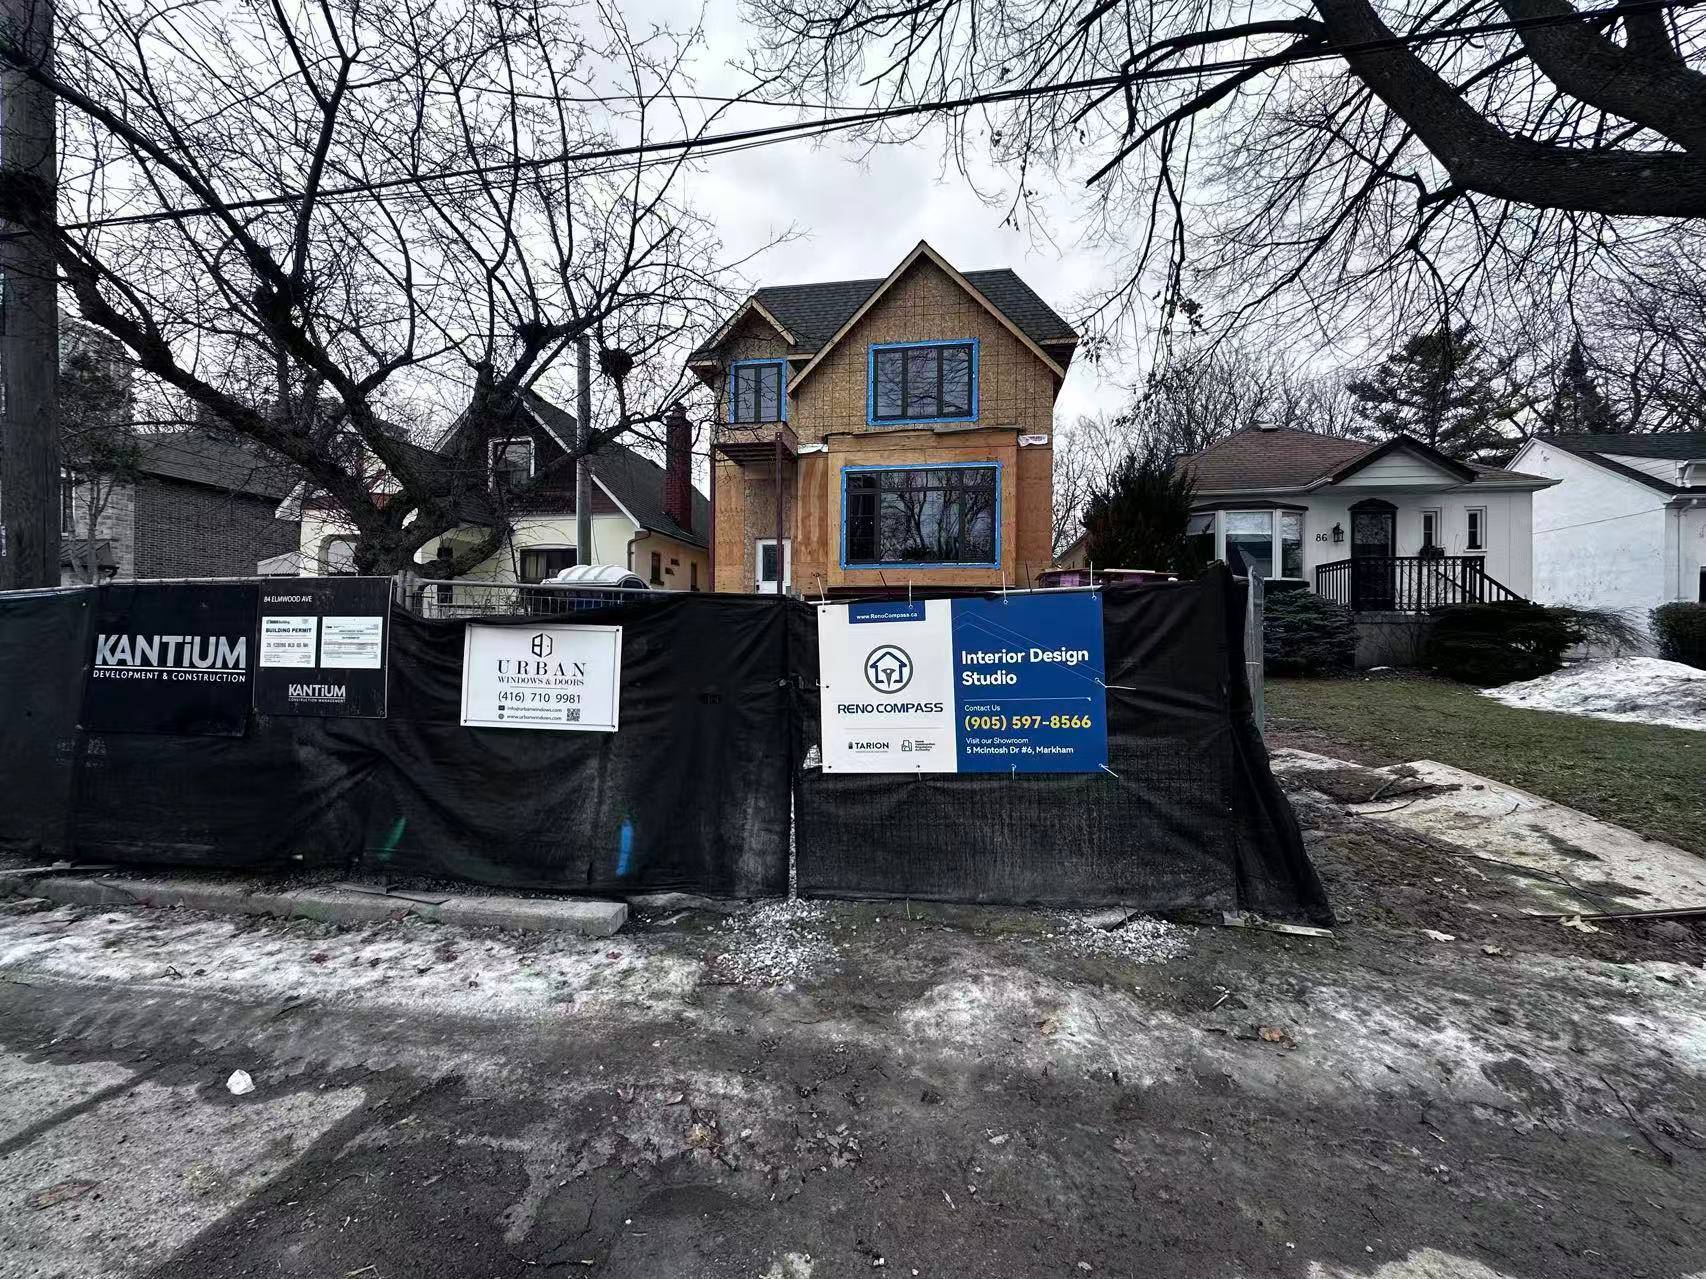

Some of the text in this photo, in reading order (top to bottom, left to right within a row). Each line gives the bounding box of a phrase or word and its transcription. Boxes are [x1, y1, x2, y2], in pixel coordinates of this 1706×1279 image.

[1315, 533, 1328, 542] 86
[263, 595, 313, 603] 84 ELMWOOD AVE
[856, 612, 918, 620] www.RenoCompass.ca
[961, 647, 1089, 666] Interior Design
[497, 660, 586, 677] URBAN
[93, 670, 246, 682] DEVELOPMENT & CONSTRUCTION
[498, 676, 544, 684] WINDOWS
[554, 678, 584, 686] DOORS
[962, 670, 1017, 685] Studio
[498, 691, 581, 704] (416) 710 9981
[837, 702, 944, 714] RENO COMPASS
[964, 704, 1001, 712] Contact Us
[964, 715, 1092, 731] (905) 597-8566
[855, 742, 890, 750] TARION
[1010, 746, 1020, 754] Dr
[1021, 746, 1034, 754] #6,
[1036, 746, 1074, 754] Markham
